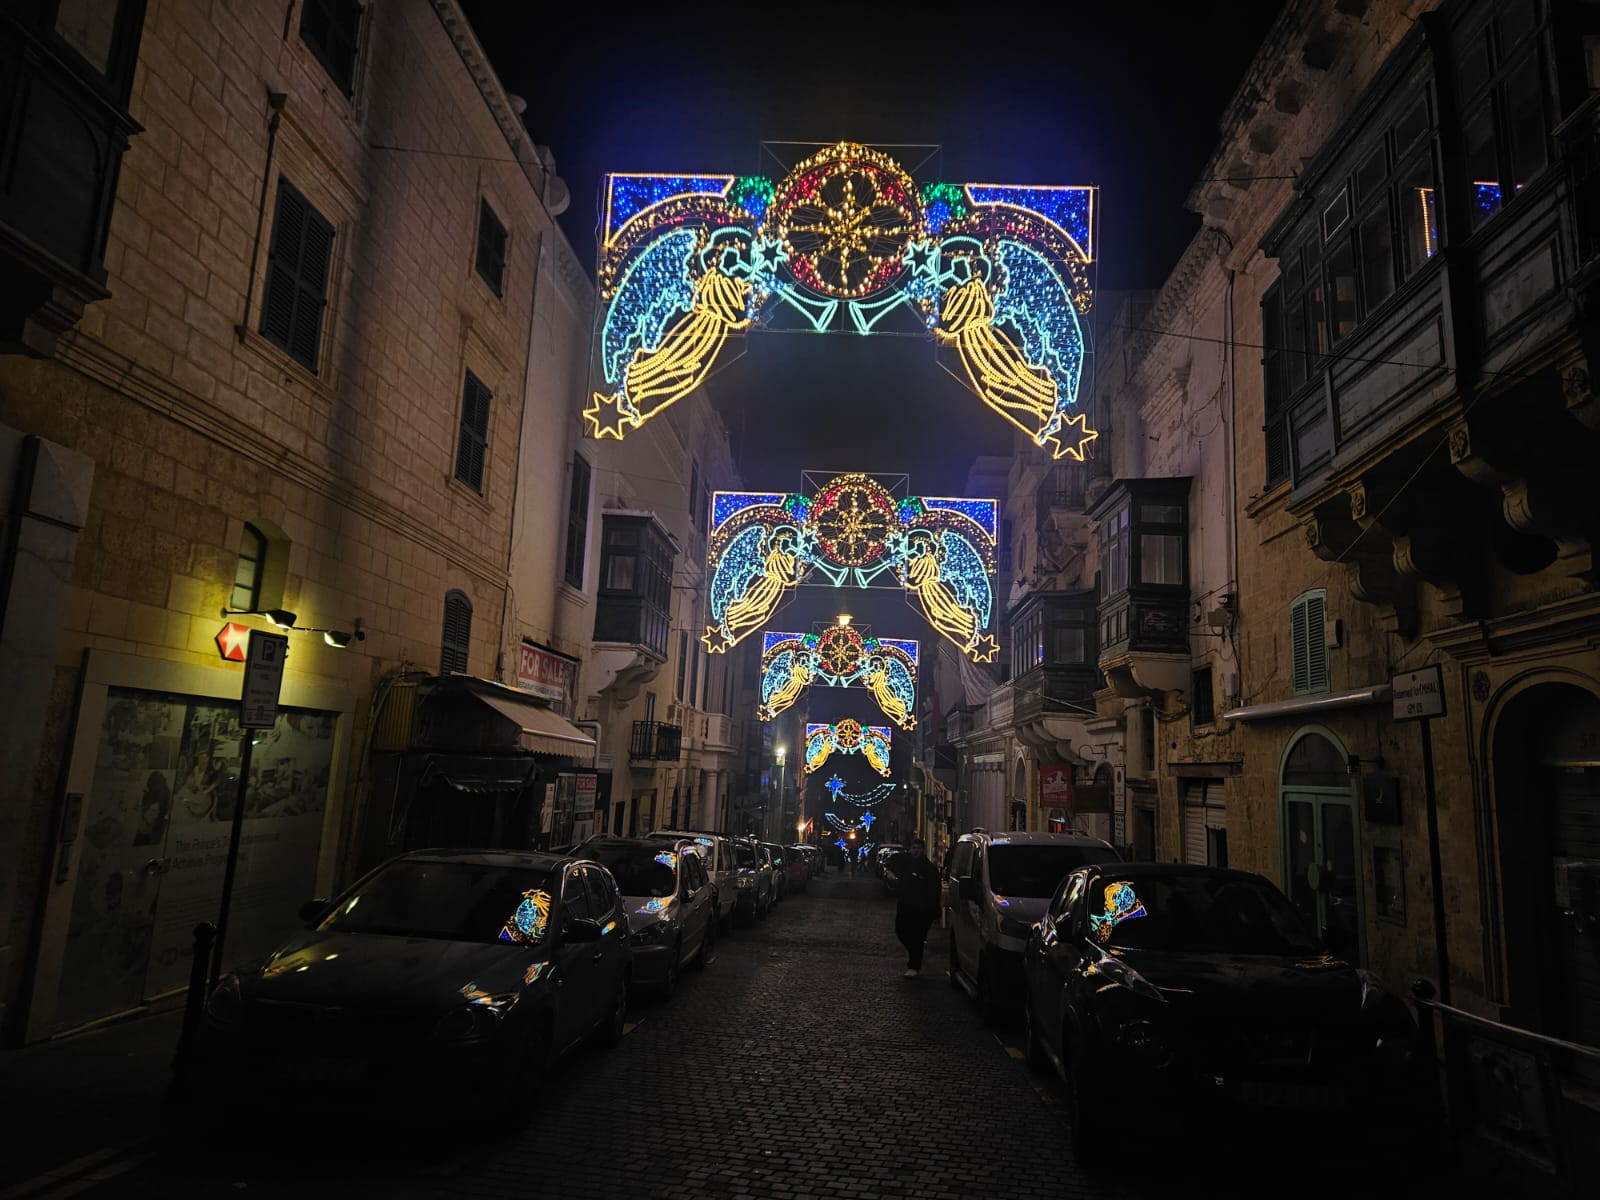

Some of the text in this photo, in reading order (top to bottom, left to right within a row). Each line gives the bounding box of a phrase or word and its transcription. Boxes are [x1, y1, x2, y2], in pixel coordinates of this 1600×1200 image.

[521, 649, 563, 683] FOR SALE
[176, 840, 191, 850] The
[192, 838, 221, 850] Prince's
